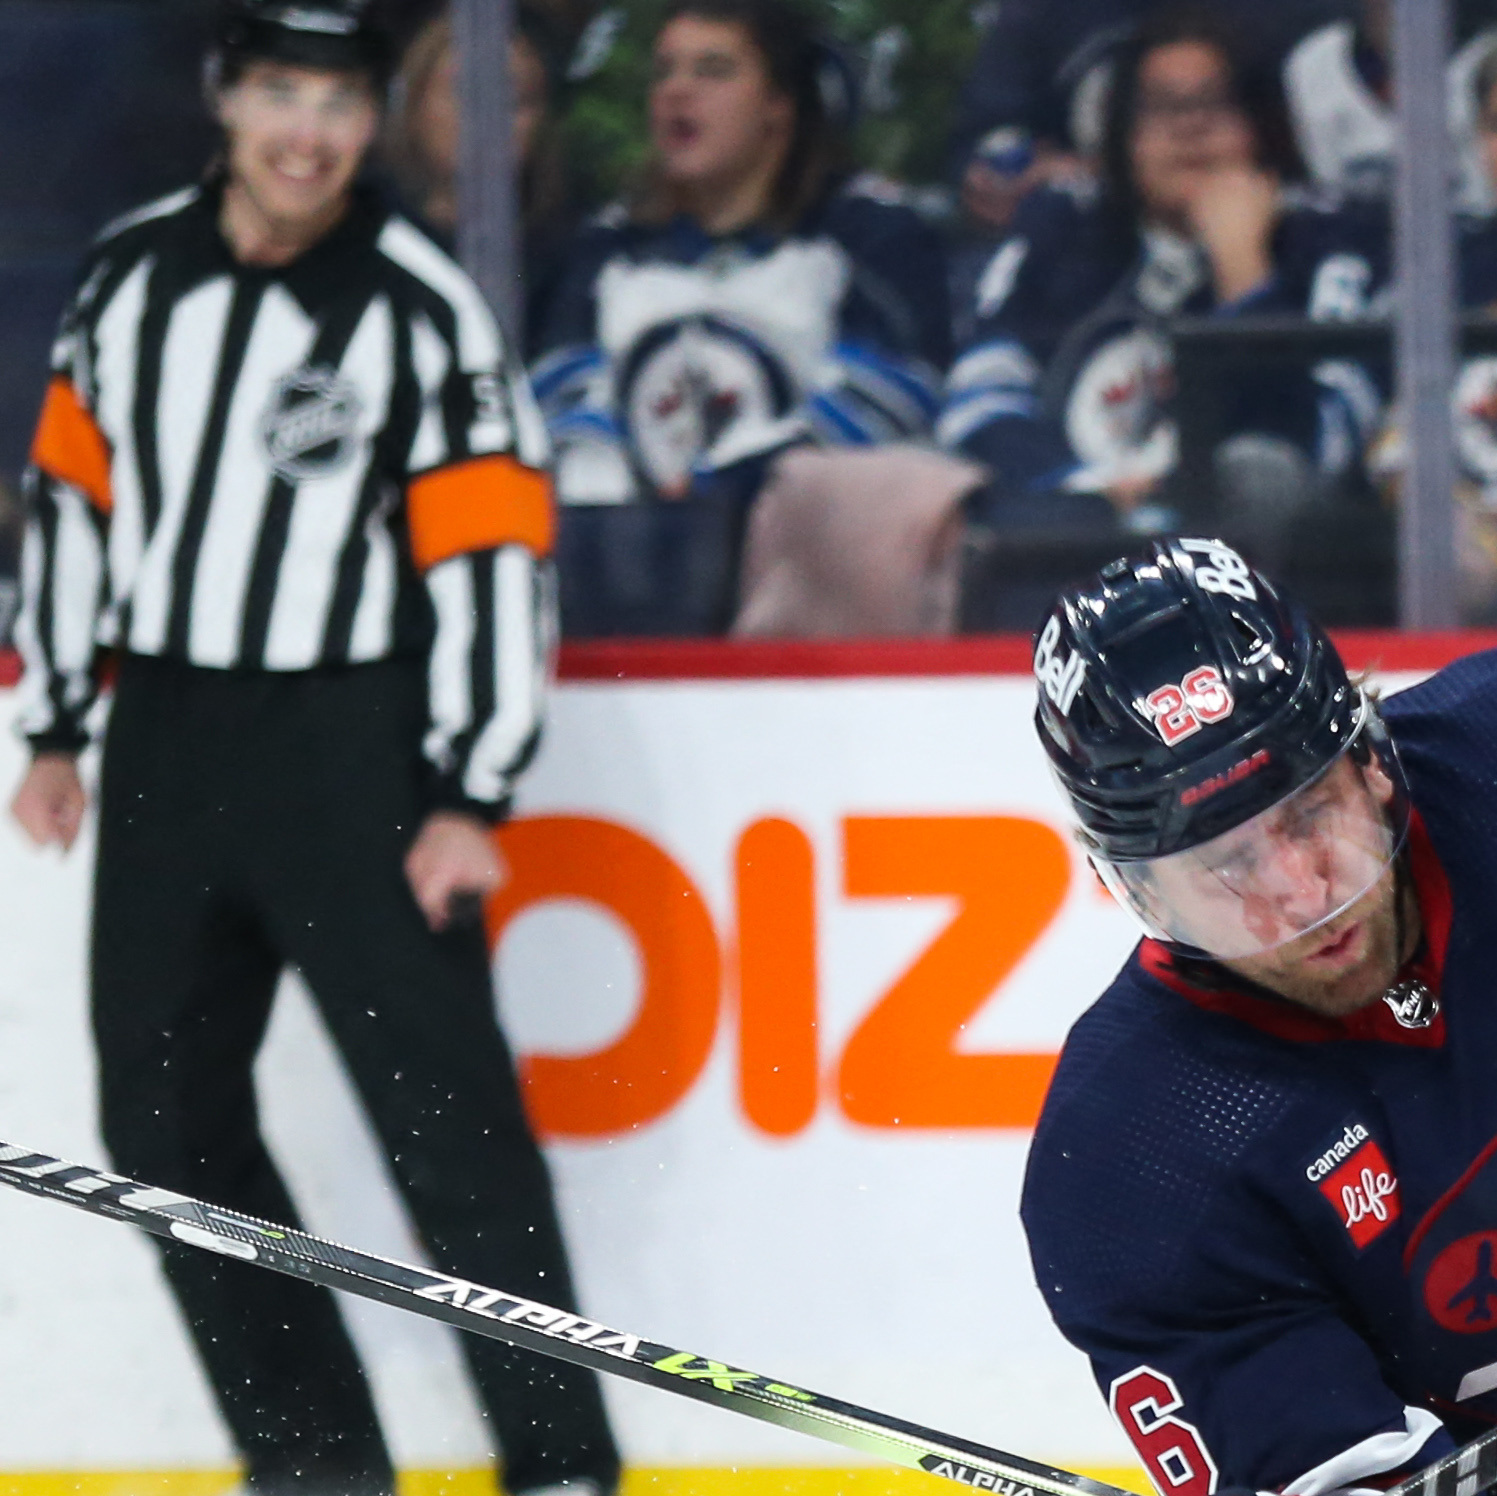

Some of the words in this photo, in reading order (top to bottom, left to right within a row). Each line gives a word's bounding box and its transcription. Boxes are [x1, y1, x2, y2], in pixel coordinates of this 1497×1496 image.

[1178, 537, 1258, 602] Bell
[1033, 615, 1087, 717] Bell
[1145, 664, 1235, 747] 26
[1306, 1124, 1369, 1181] canada
[1341, 1168, 1397, 1228] life
[412, 1281, 643, 1358] ALPHA
